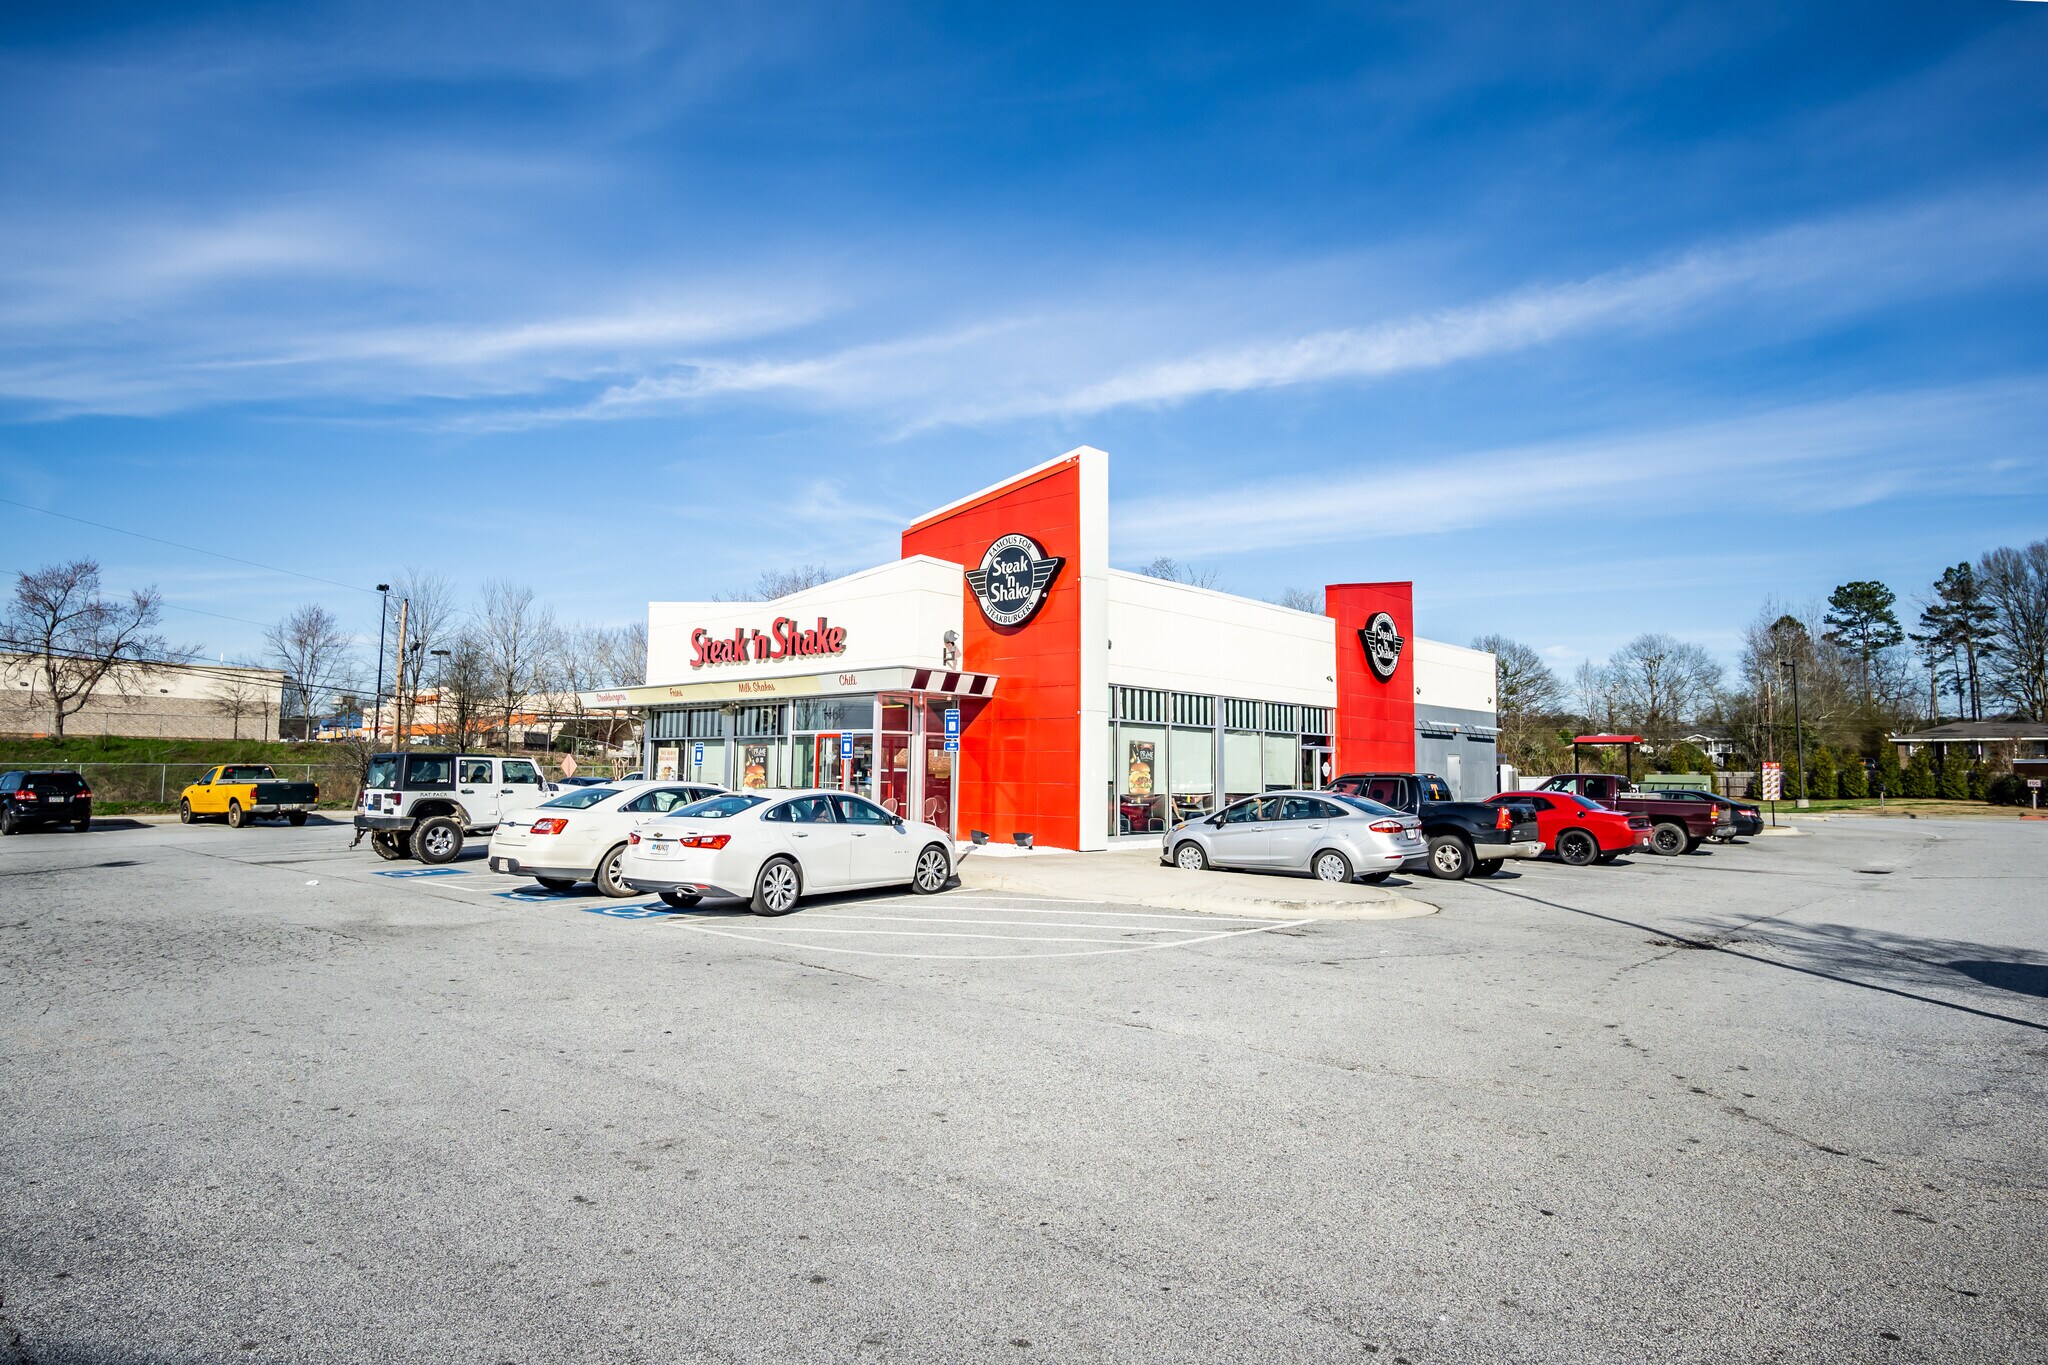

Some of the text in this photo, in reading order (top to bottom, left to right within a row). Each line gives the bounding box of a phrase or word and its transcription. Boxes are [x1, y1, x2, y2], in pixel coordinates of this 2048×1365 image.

[988, 536, 1033, 557] FAMOUS FOR
[992, 555, 1028, 576] Steak
[1005, 574, 1016, 588] 'n
[990, 582, 1029, 603] Shake
[985, 601, 1034, 623] STEAKBURGERS
[1377, 626, 1393, 641] Steak
[690, 616, 848, 668] Steak 'n Shake
[1377, 643, 1394, 660] Shake
[738, 681, 776, 693] Milk Shakes
[838, 674, 857, 687] Chili
[596, 693, 626, 705] Steakburgers
[669, 687, 684, 697] Fries
